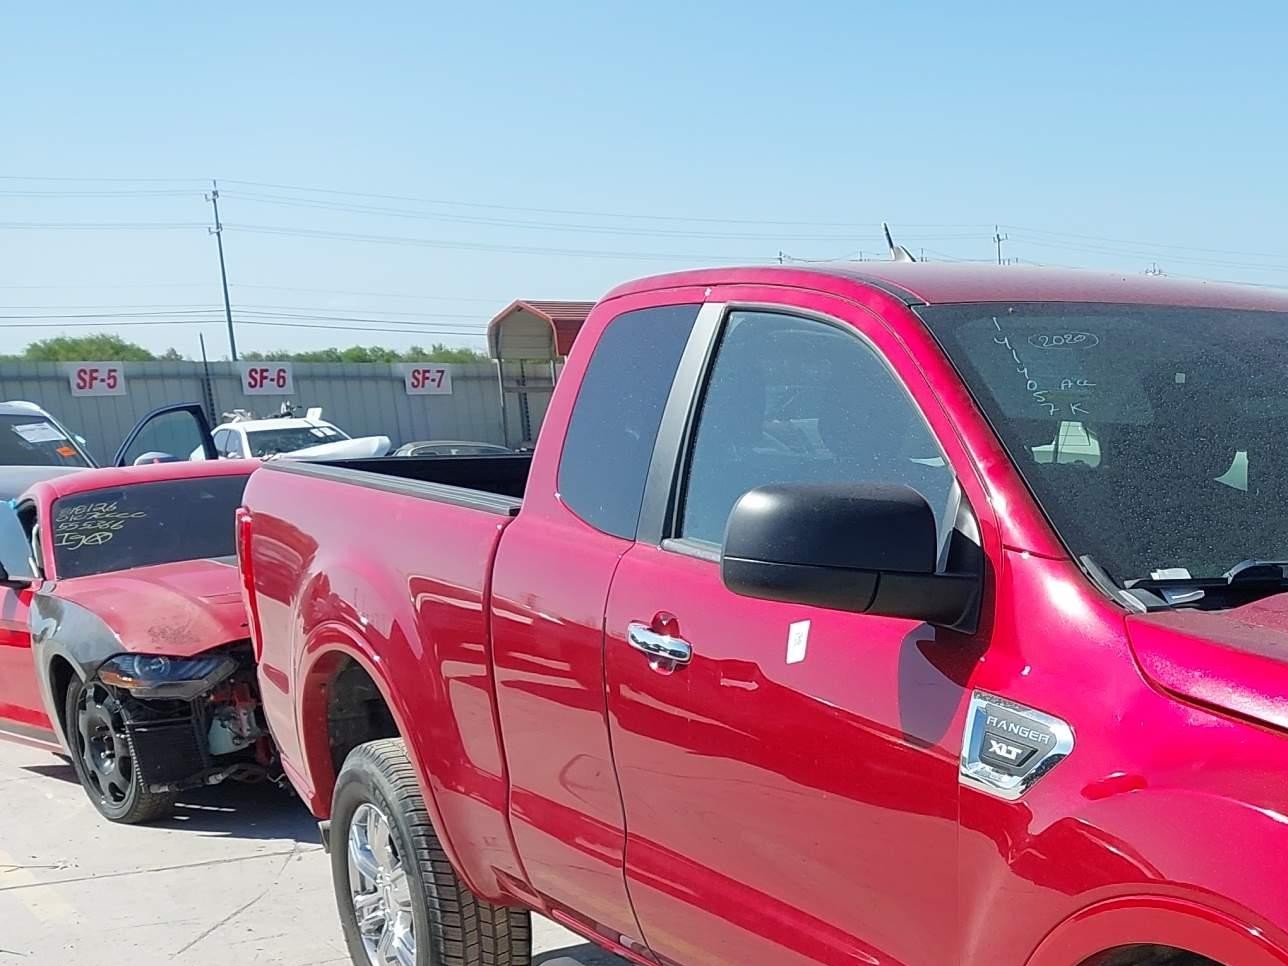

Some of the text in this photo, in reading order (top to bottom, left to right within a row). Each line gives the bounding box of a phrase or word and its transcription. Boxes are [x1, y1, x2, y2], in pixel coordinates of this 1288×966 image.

[76, 368, 118, 390] SF-5
[248, 367, 286, 389] SF-6
[411, 368, 445, 389] SF-7
[987, 716, 1051, 744] RANGER
[989, 740, 1023, 760] XLT
